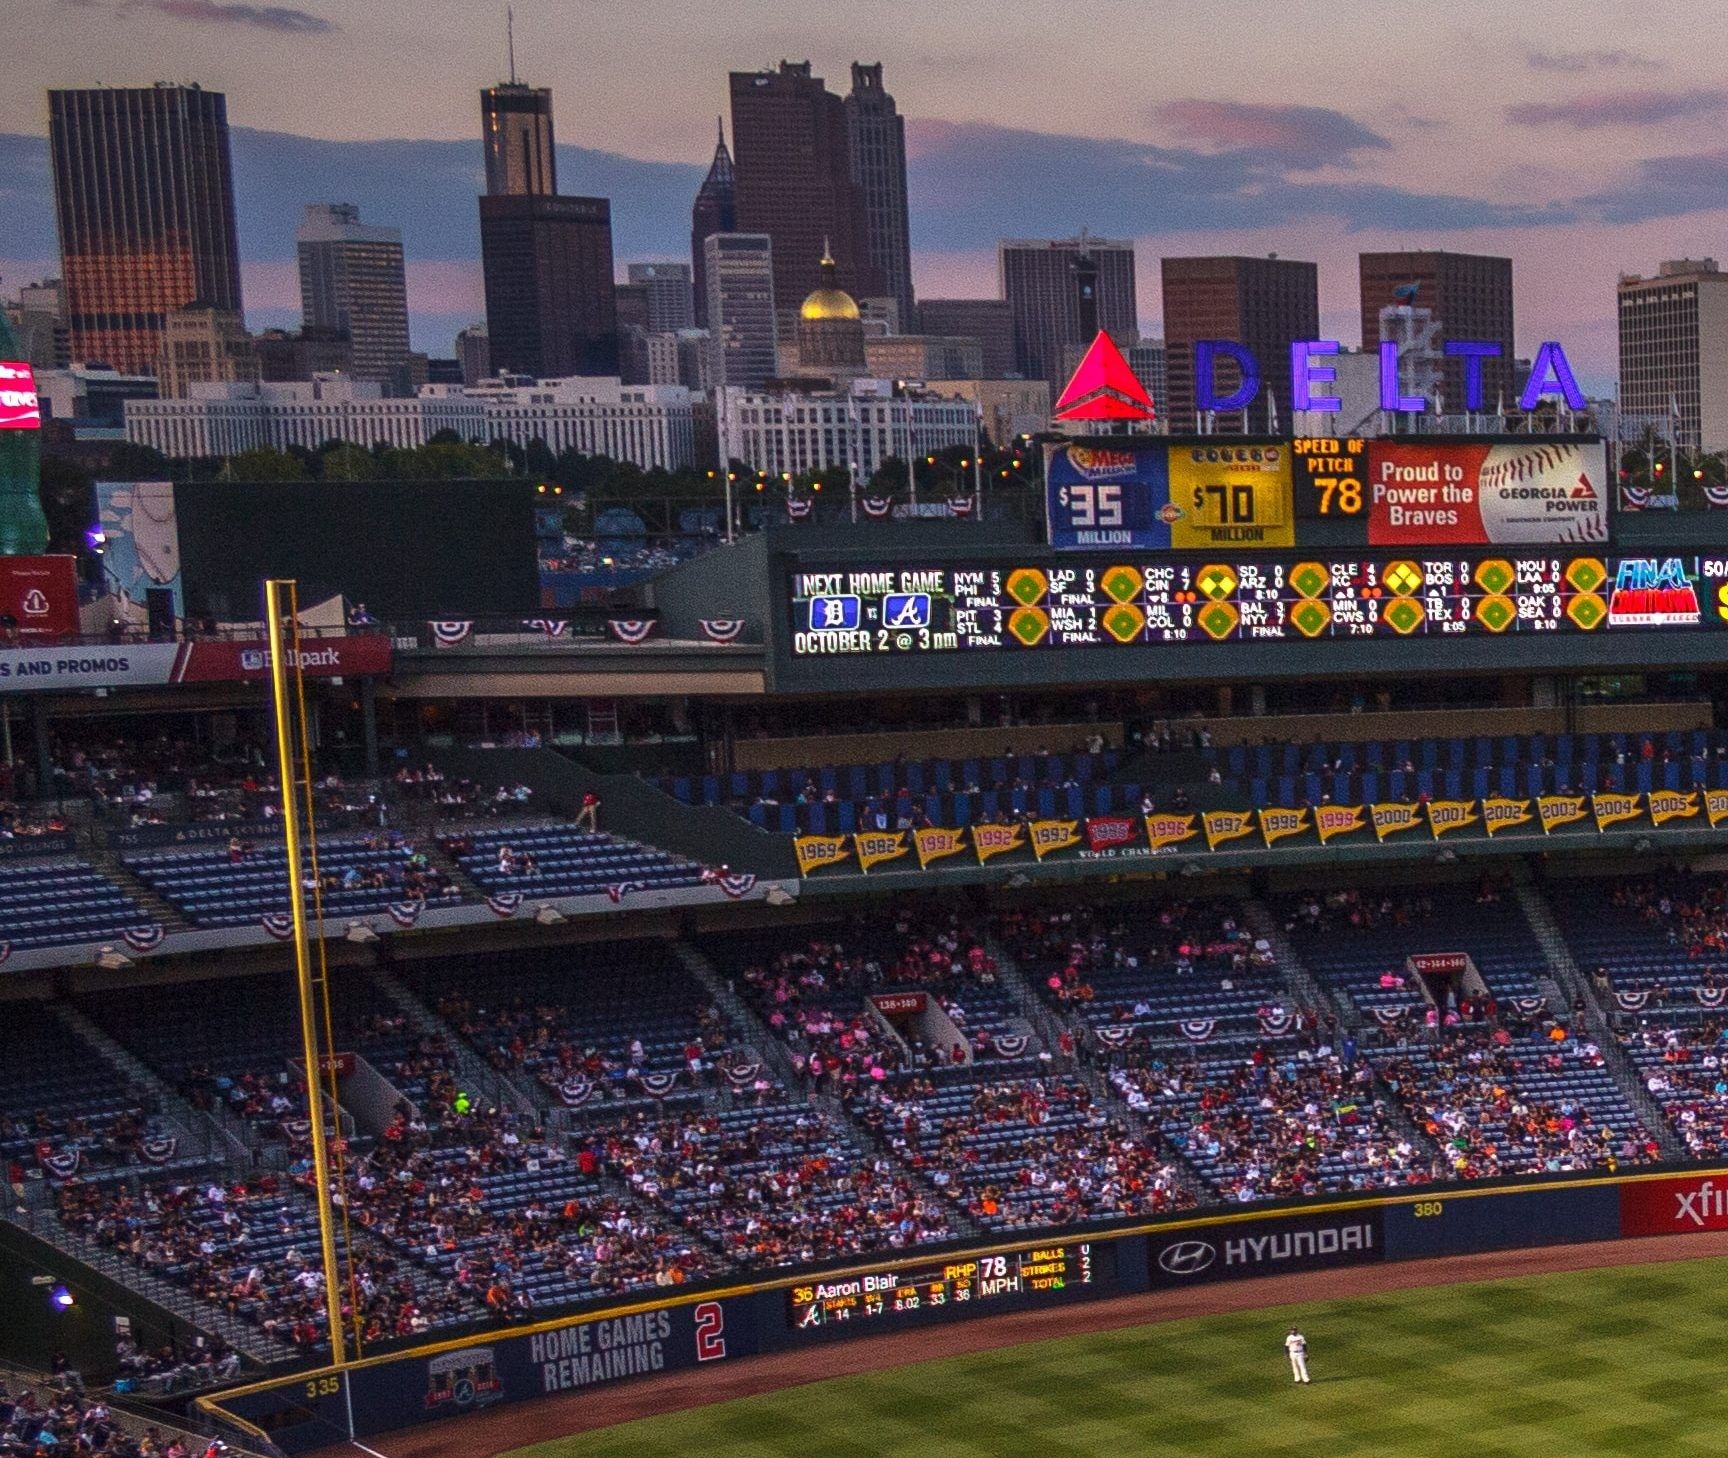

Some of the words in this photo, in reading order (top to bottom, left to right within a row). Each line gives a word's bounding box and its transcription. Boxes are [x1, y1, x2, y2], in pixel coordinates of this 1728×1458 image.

[1194, 341, 1587, 412] DELTA
[1294, 439, 1339, 454] SPEED
[1348, 439, 1364, 453] OF
[1308, 458, 1353, 472] PITCH
[1382, 461, 1438, 481] Proud
[1444, 464, 1462, 481] to
[1314, 478, 1362, 514] 78
[1373, 484, 1438, 504] Power
[1442, 484, 1473, 503] the
[1500, 488, 1567, 499] GEORGIA
[1059, 485, 1122, 526] $35
[1194, 485, 1254, 523] $70
[1546, 500, 1598, 512] POWER
[1390, 506, 1458, 525] Braves
[1077, 531, 1131, 544] MILLION
[1211, 527, 1264, 541] MILLION
[1049, 570, 1075, 581] LAD
[1145, 568, 1174, 579] CHC
[1425, 562, 1452, 573] TOR
[1516, 561, 1545, 572] HOU
[1616, 558, 1692, 589] FINAL
[803, 574, 843, 595] NEXT
[849, 573, 894, 594] HOME
[901, 571, 944, 593] GAME
[954, 573, 983, 584] NYM
[1253, 626, 1285, 637] FINAL
[795, 631, 871, 653] OCTOBER
[877, 629, 889, 650] 2
[896, 634, 912, 649] @
[919, 629, 929, 649] 3
[16, 660, 50, 676] AND
[58, 657, 129, 673] PROMOS
[1432, 806, 1466, 823] 2001
[1486, 804, 1521, 820] 2002
[1263, 815, 1298, 831] 1998
[1035, 827, 1070, 844] 1993
[860, 839, 896, 857] 1982
[1413, 1202, 1443, 1217] 380
[1225, 1224, 1373, 1265] HYUNDAI
[816, 1281, 860, 1299] Aaron
[864, 1274, 899, 1294] Blair
[981, 1256, 1007, 1277] 78
[980, 1277, 1018, 1296] MPH
[531, 1325, 591, 1364] HOME
[599, 1310, 671, 1346] GAMES
[695, 1302, 726, 1361] 2
[543, 1342, 664, 1391] REMAINING
[306, 1378, 339, 1398] 335
